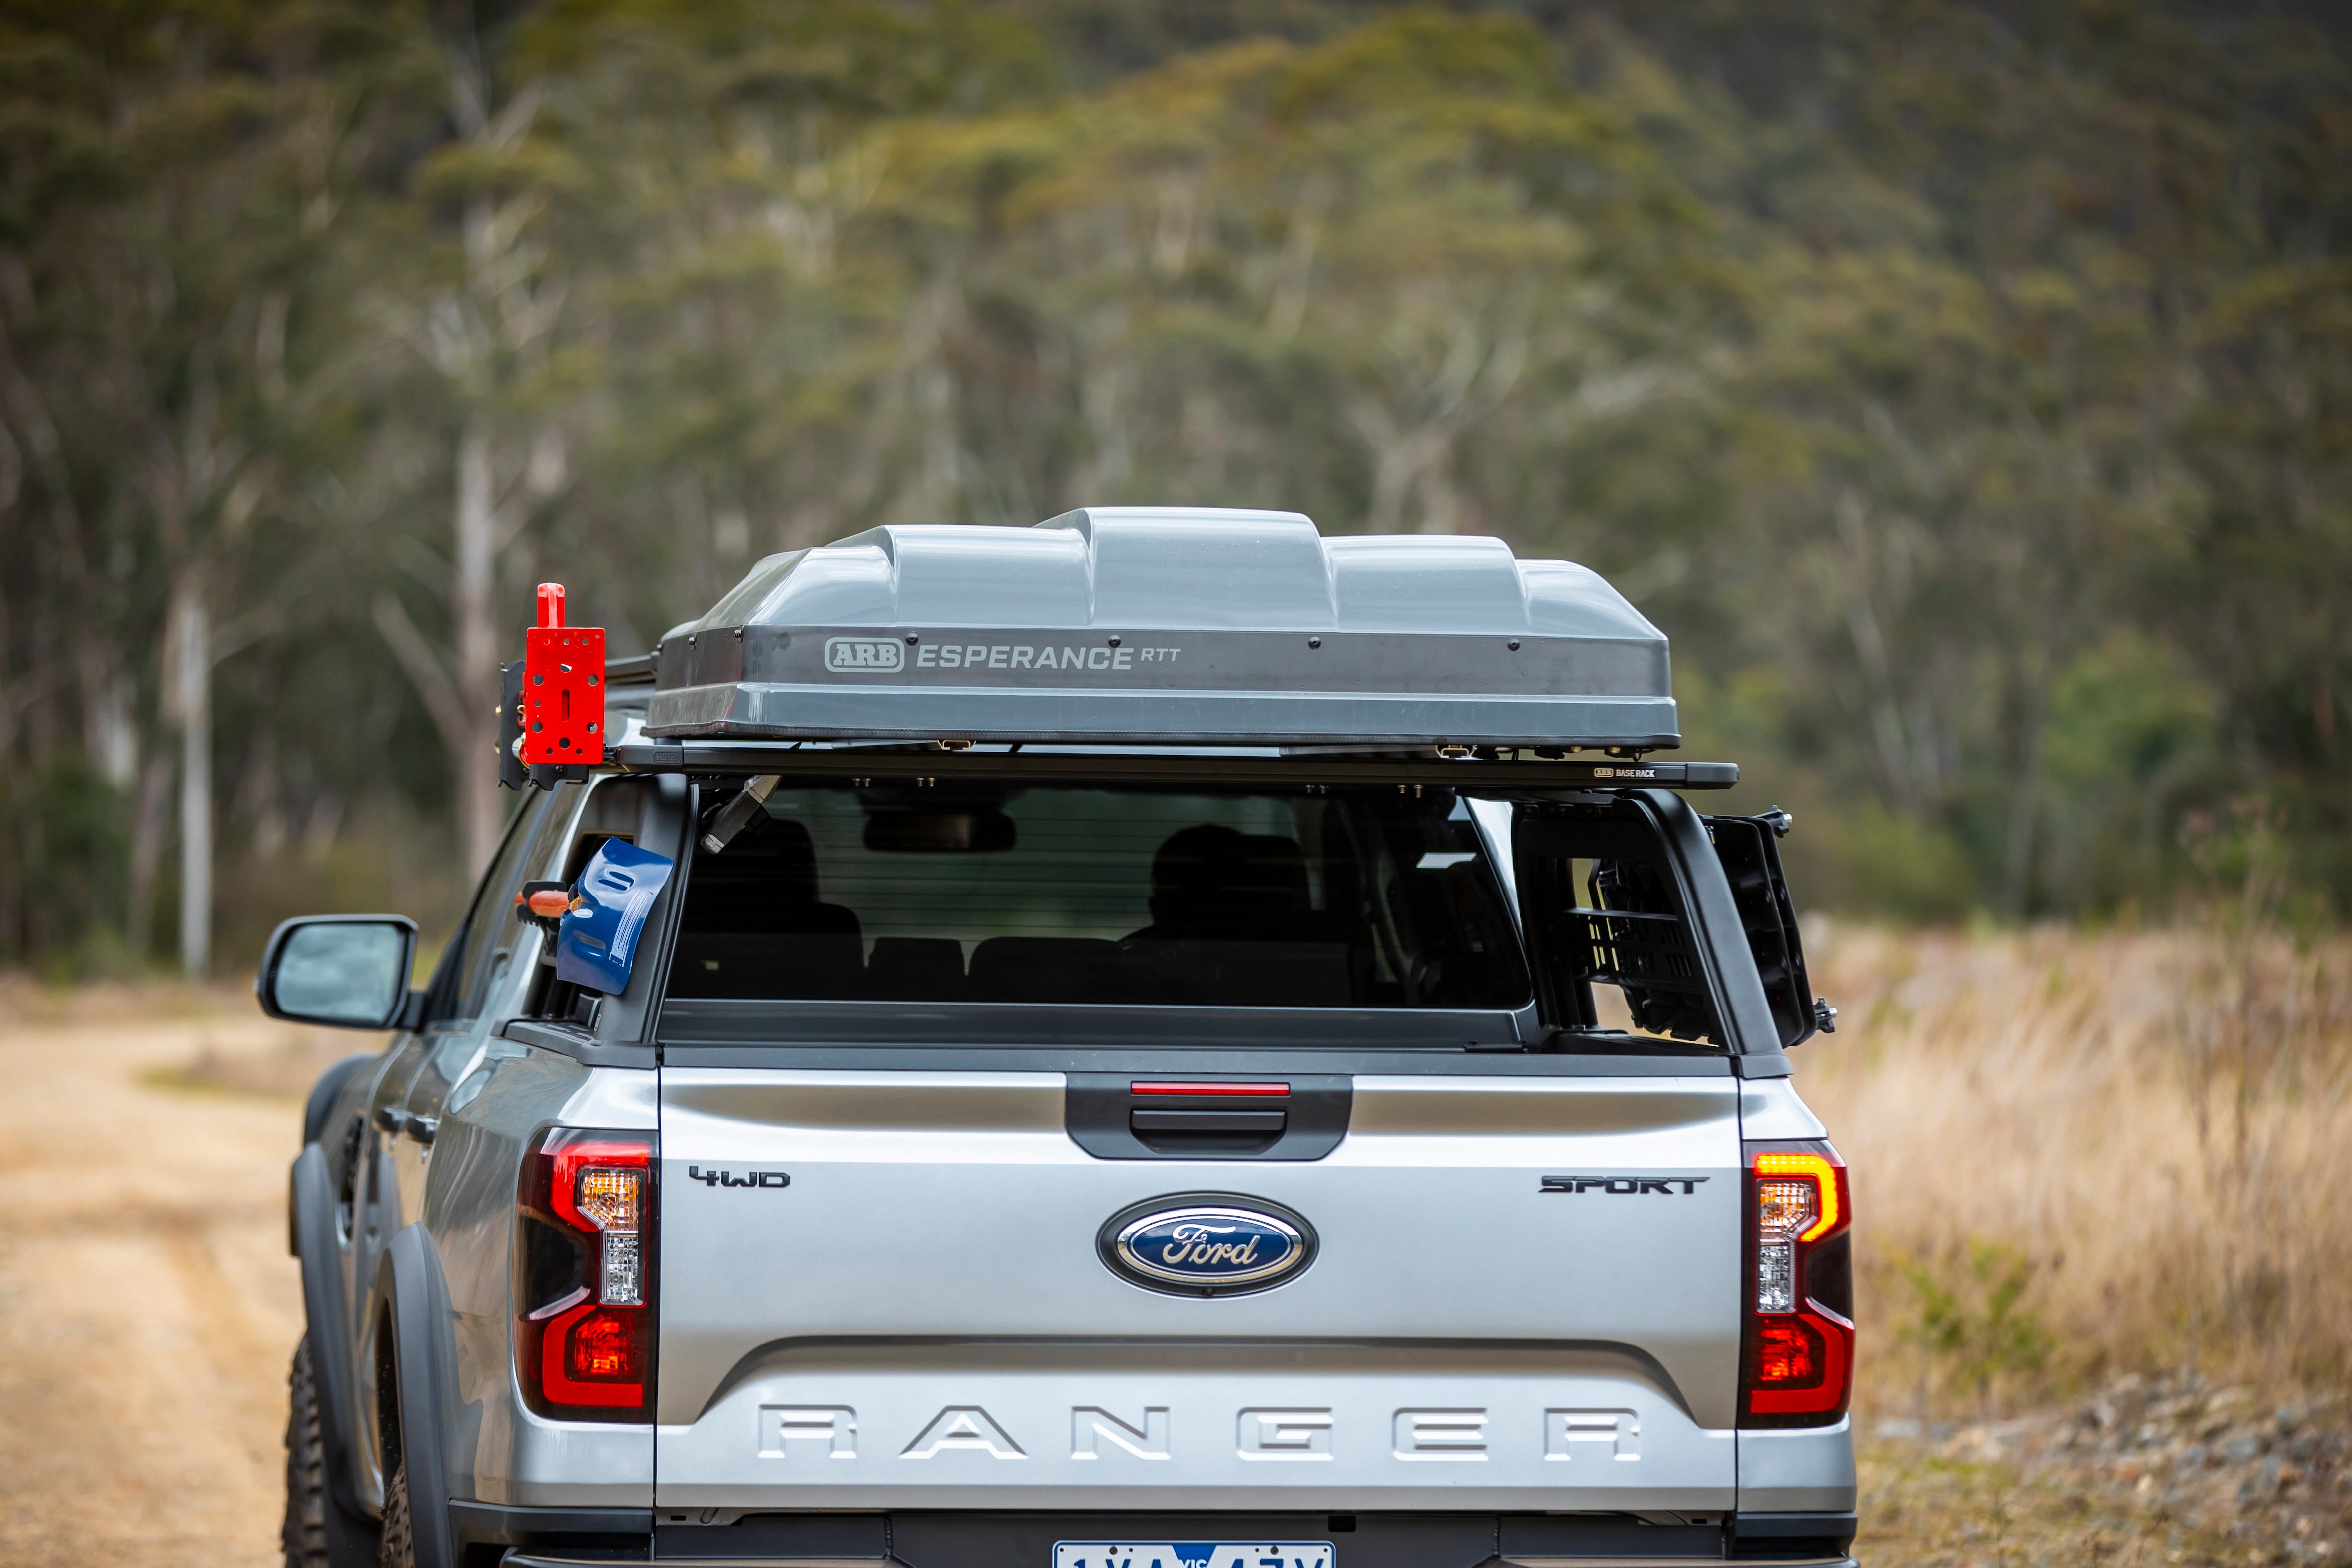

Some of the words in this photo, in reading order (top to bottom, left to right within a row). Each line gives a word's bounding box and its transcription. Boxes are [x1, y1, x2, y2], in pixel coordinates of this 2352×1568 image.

[833, 644, 897, 666] ARB
[916, 645, 1133, 670] ESPERANCE
[1140, 648, 1181, 662] RTT
[657, 753, 680, 761] ARB
[1636, 769, 1655, 778] RACK
[689, 1166, 791, 1188] 4WD
[1539, 1175, 1710, 1194] SPORT
[1163, 1224, 1261, 1264] Ford
[758, 1404, 1641, 1462] RANGER
